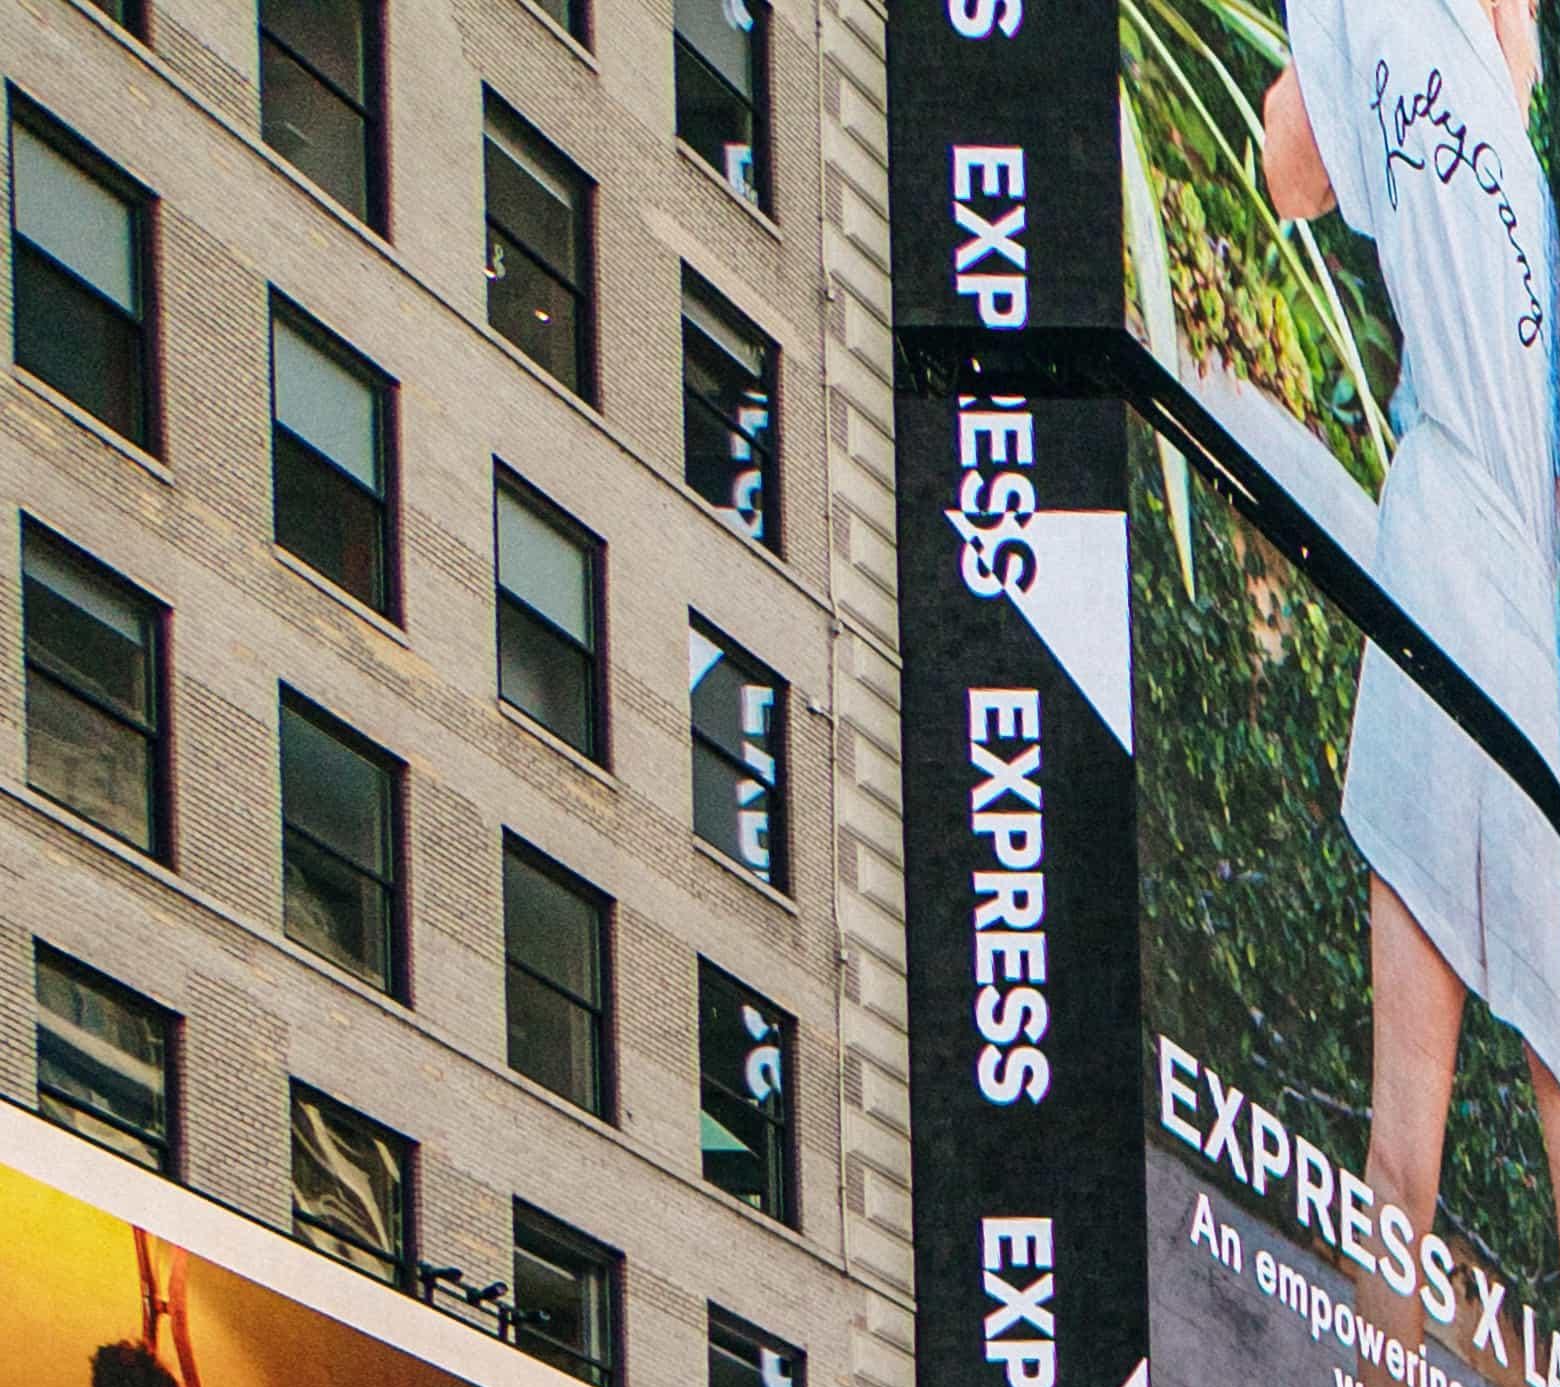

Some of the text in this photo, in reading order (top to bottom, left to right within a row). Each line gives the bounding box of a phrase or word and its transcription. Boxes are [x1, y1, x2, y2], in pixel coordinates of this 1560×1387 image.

[967, 688, 1051, 1105] EXPRESS
[1155, 1034, 1508, 1369] EXPRESS X
[1191, 1192, 1243, 1273] An
